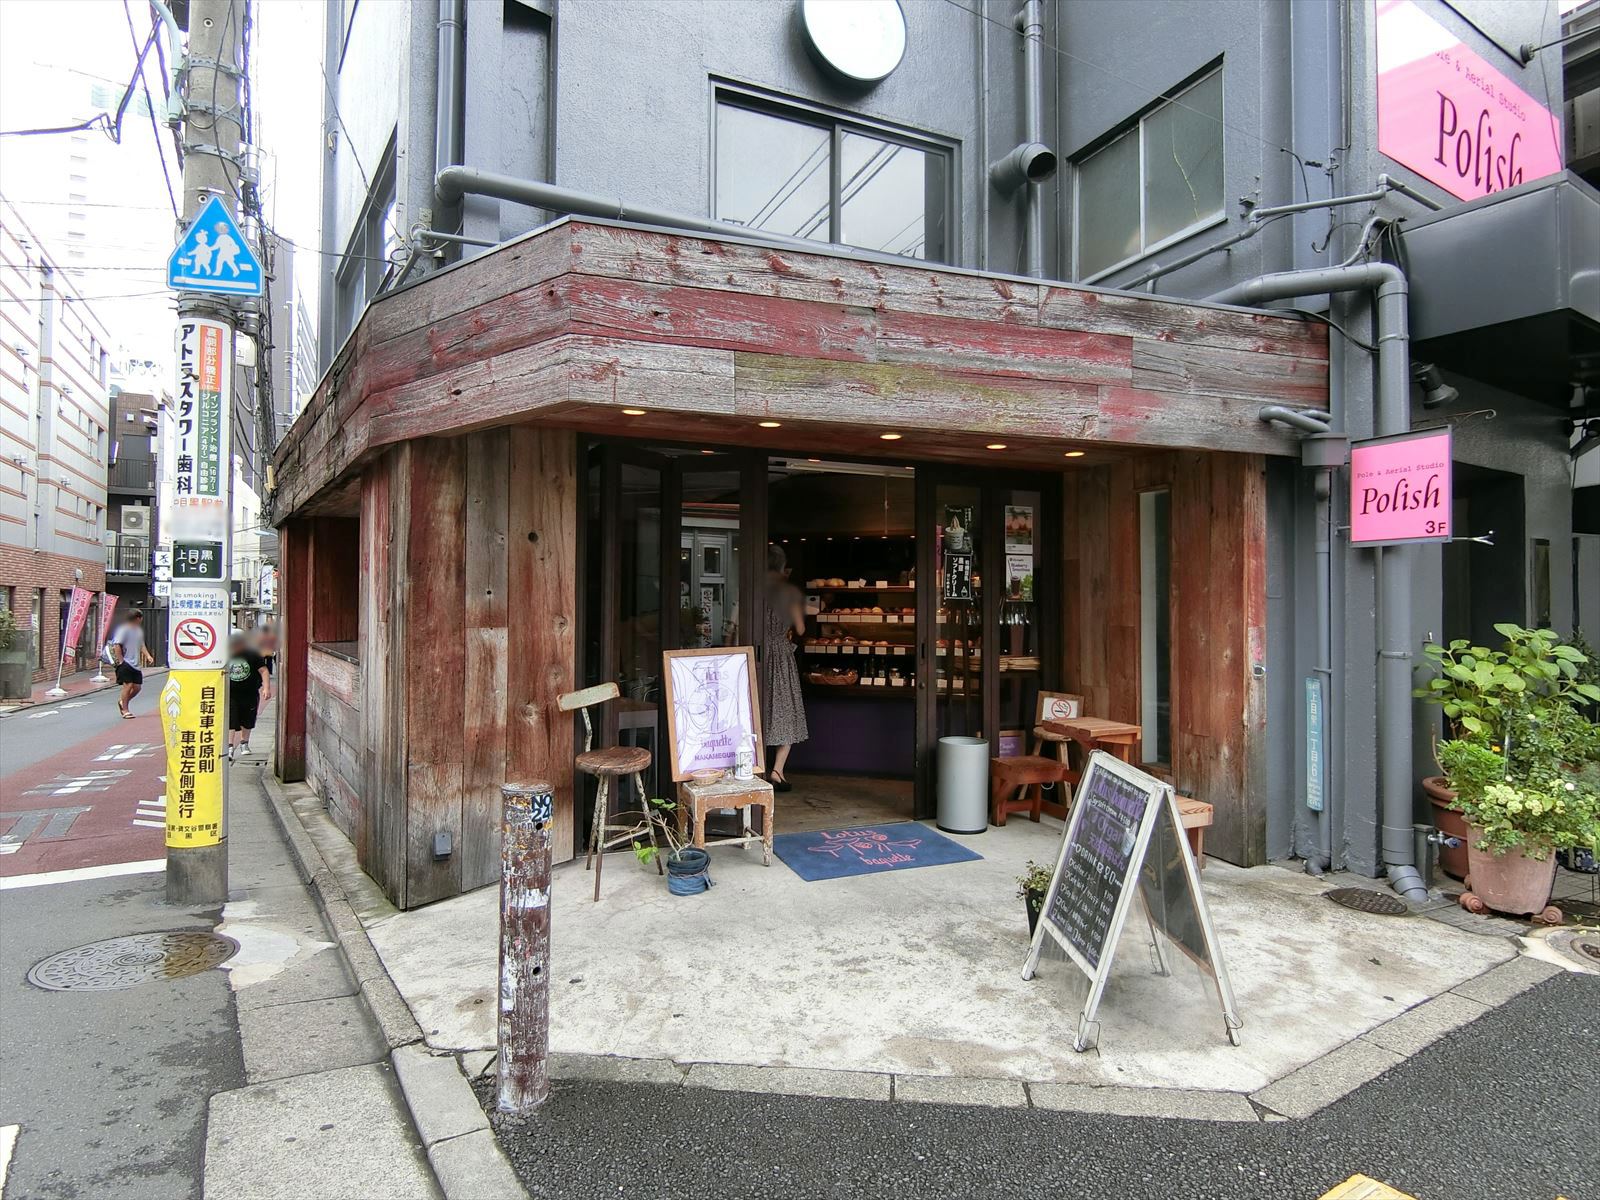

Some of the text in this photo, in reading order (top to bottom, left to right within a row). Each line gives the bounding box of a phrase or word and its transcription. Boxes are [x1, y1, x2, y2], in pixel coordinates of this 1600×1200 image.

[1499, 92, 1526, 122] Studio
[1435, 90, 1522, 193] Polish
[177, 324, 195, 495] アトラスタワー歯科
[1386, 465, 1412, 475] Aerial
[1416, 461, 1445, 471] Studio
[1360, 474, 1440, 515] Polish
[1425, 520, 1447, 534] 3F
[175, 548, 214, 561] 上目黒
[180, 562, 208, 574] 1-6
[951, 557, 959, 597] ソフトクリーム
[199, 685, 216, 774] 自転車は原則
[179, 730, 196, 819] 車道左側通行
[860, 853, 915, 867] baguette
[1080, 847, 1097, 868] DRINK
